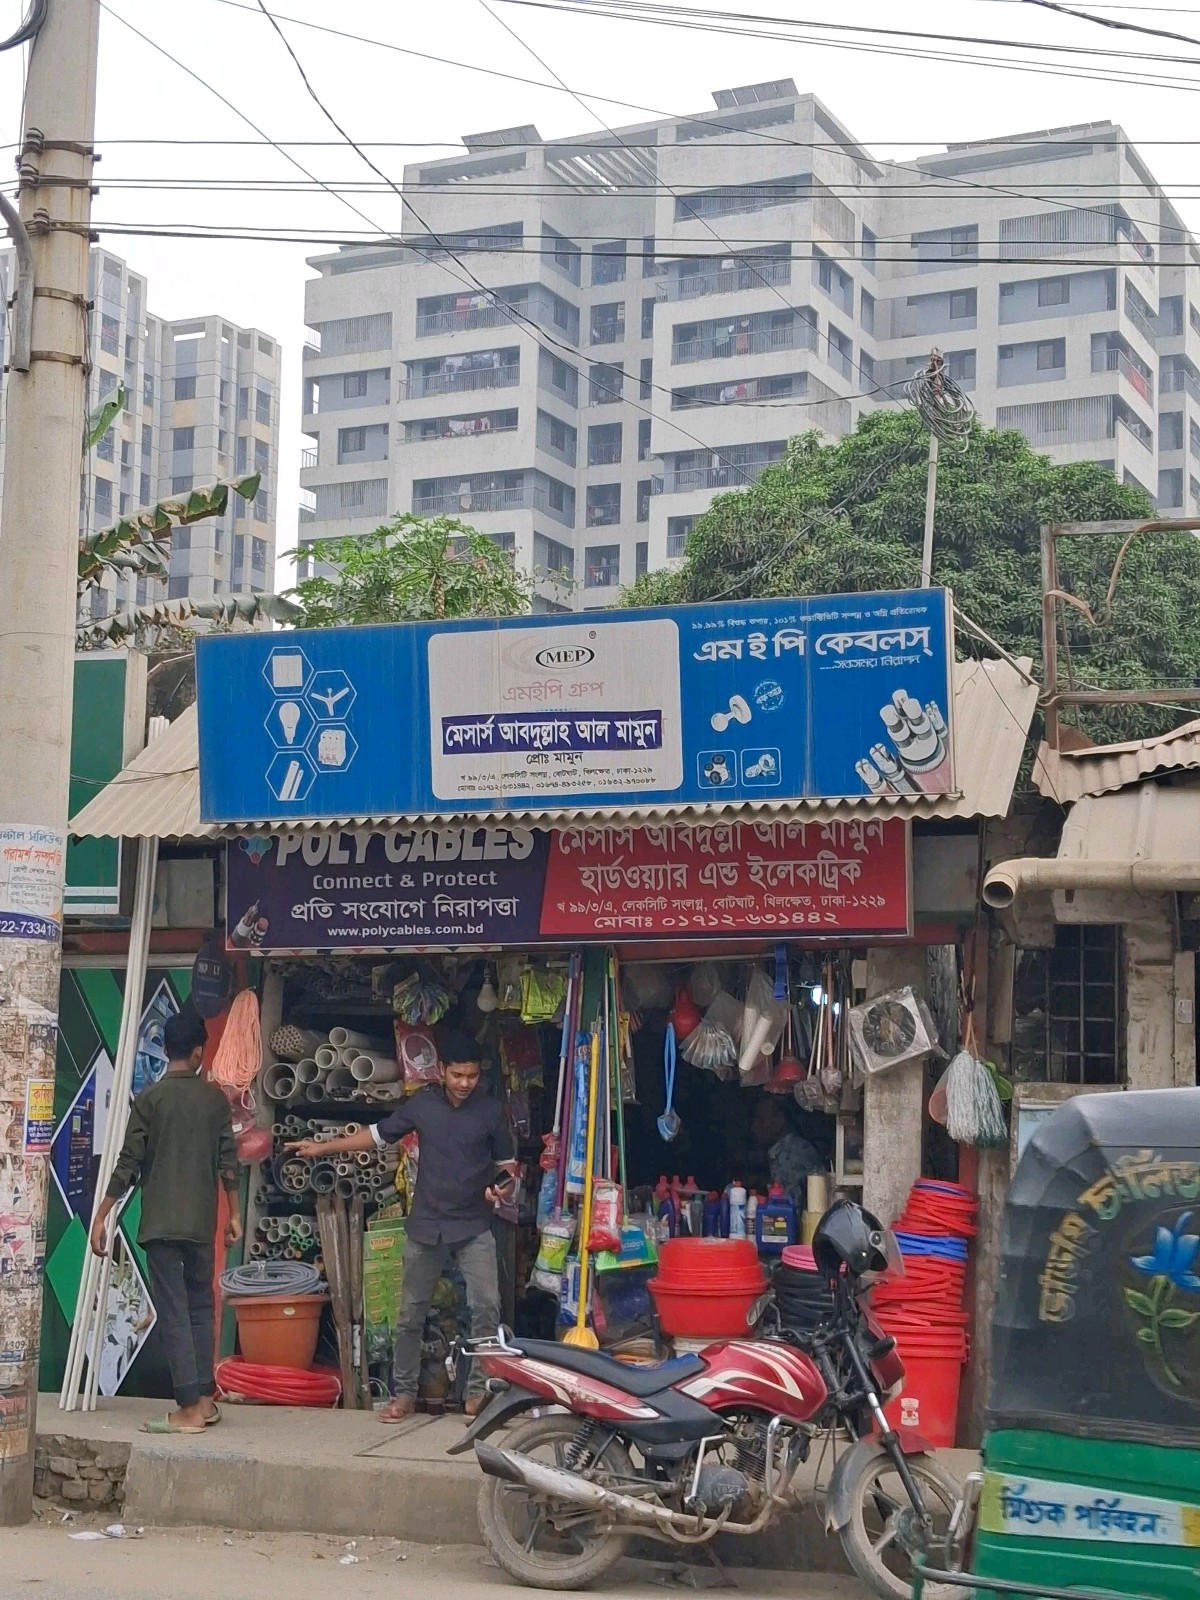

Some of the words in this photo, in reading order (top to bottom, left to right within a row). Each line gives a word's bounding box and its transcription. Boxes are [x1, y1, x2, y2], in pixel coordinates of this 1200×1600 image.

[815, 626, 934, 656] কেবলস্
[545, 649, 586, 663] MEP
[880, 655, 921, 667] নিরাপদ
[502, 679, 564, 701] এমইপি
[568, 681, 605, 698] গ্রুপ
[445, 715, 496, 747] মেসার্স
[498, 718, 571, 750] আবদুল্লাহ
[575, 718, 611, 744] আল
[615, 718, 658, 748] মামুন
[553, 751, 583, 765] মামুন
[752, 819, 806, 849] আল
[818, 817, 884, 855] মামুন
[276, 831, 373, 867] POLY
[384, 828, 535, 864] CABLES
[313, 872, 393, 890] Connect
[400, 872, 416, 888] &
[422, 870, 498, 887] Protect
[698, 862, 740, 890] এন্ড
[746, 849, 863, 892] ইলেকট্রিক
[291, 897, 335, 922] প্রতি
[341, 897, 427, 921] সংযোগে
[433, 894, 520, 919] নিরাপত্তা
[569, 899, 618, 915] ৯৯/৩/এ,
[621, 896, 668, 912] লেকসিটি
[671, 898, 708, 913] সংলগ্ন,
[712, 894, 760, 911] বোটঘাট,
[763, 893, 816, 911] খিলক্ষেত,
[821, 895, 886, 909] ঢাকা-১২২৯
[327, 923, 484, 938] www.polycables.com.bd
[594, 914, 653, 929] মোবাঃ
[662, 911, 840, 928] ০১৭১২-৬৩১৪৪২
